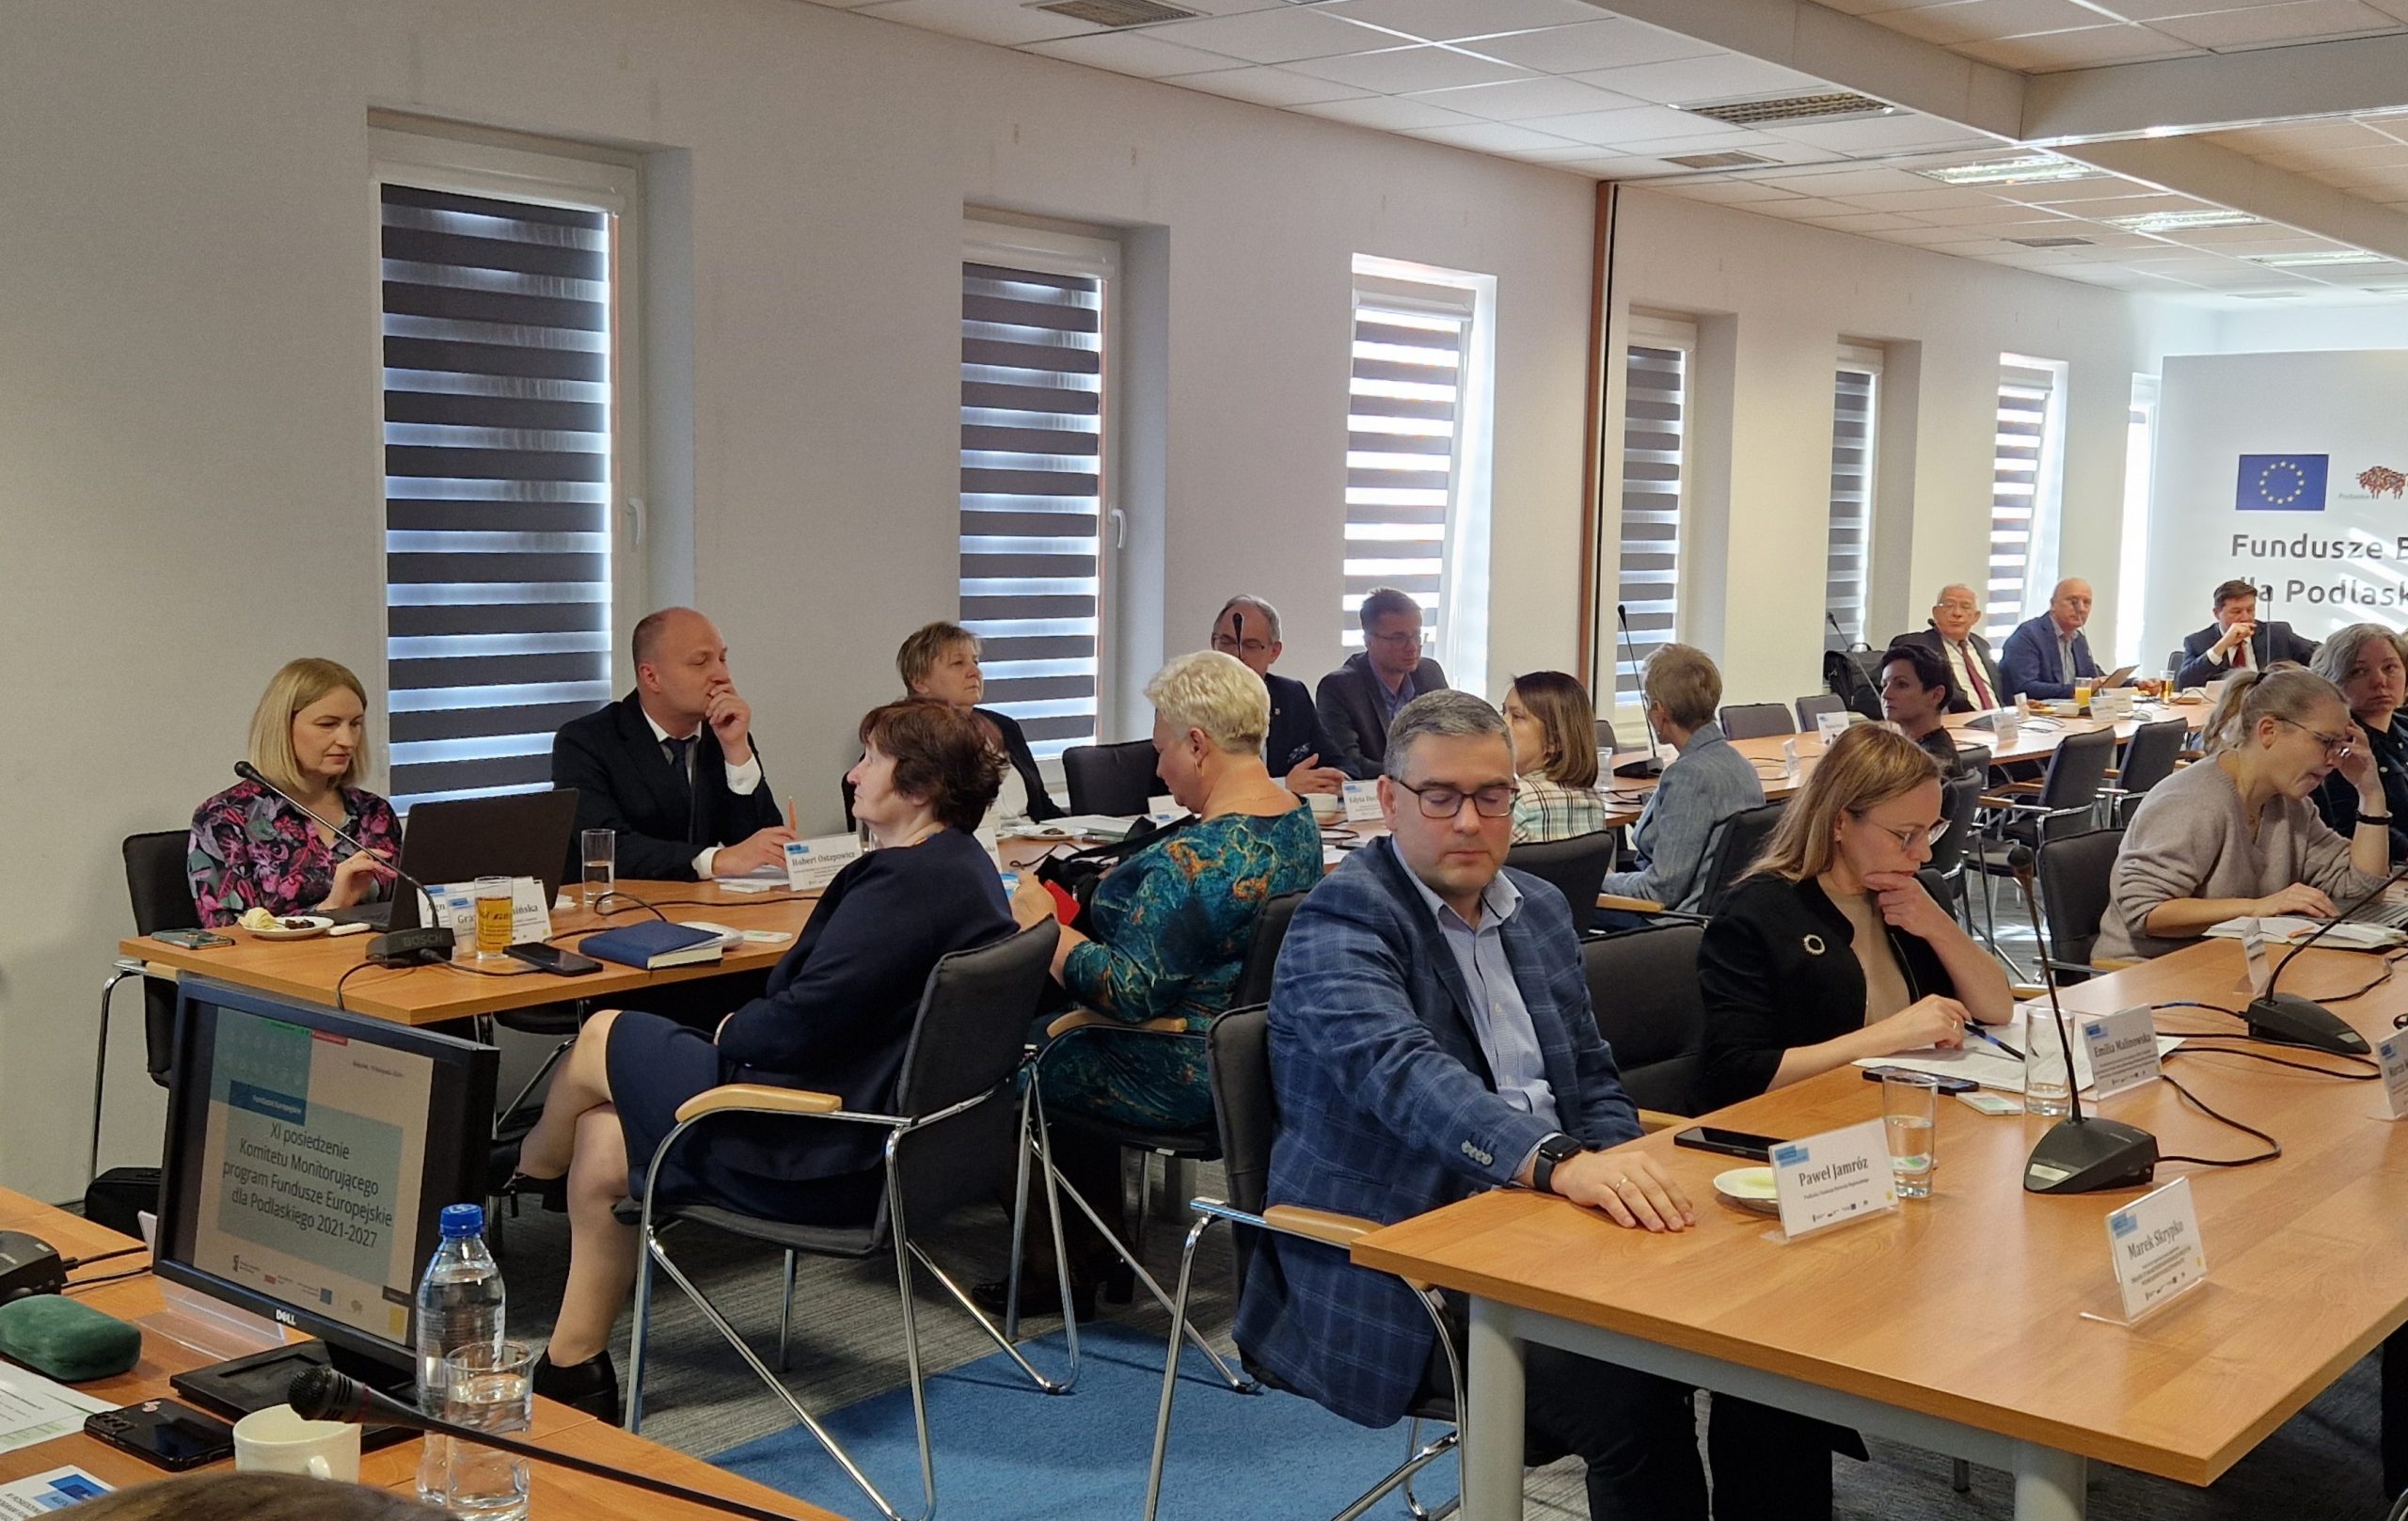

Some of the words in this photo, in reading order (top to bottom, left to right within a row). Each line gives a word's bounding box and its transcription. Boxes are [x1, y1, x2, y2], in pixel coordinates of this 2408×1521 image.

[2231, 533, 2383, 560] Fundusze
[271, 1122, 281, 1139] XI
[283, 1129, 349, 1160] posiedzenie
[240, 1137, 288, 1166] Komitetu
[292, 1153, 379, 1197] Monitorującego
[1832, 1155, 1869, 1180] Jamróz
[223, 1161, 268, 1187] program
[271, 1174, 324, 1204] Fundusze
[325, 1191, 392, 1227] Europejskie
[231, 1186, 247, 1206] dla
[250, 1193, 314, 1230] Podlaskiego
[317, 1214, 377, 1248] 2021-2027
[2128, 1236, 2154, 1260] Marek
[276, 1309, 296, 1325] DELL
